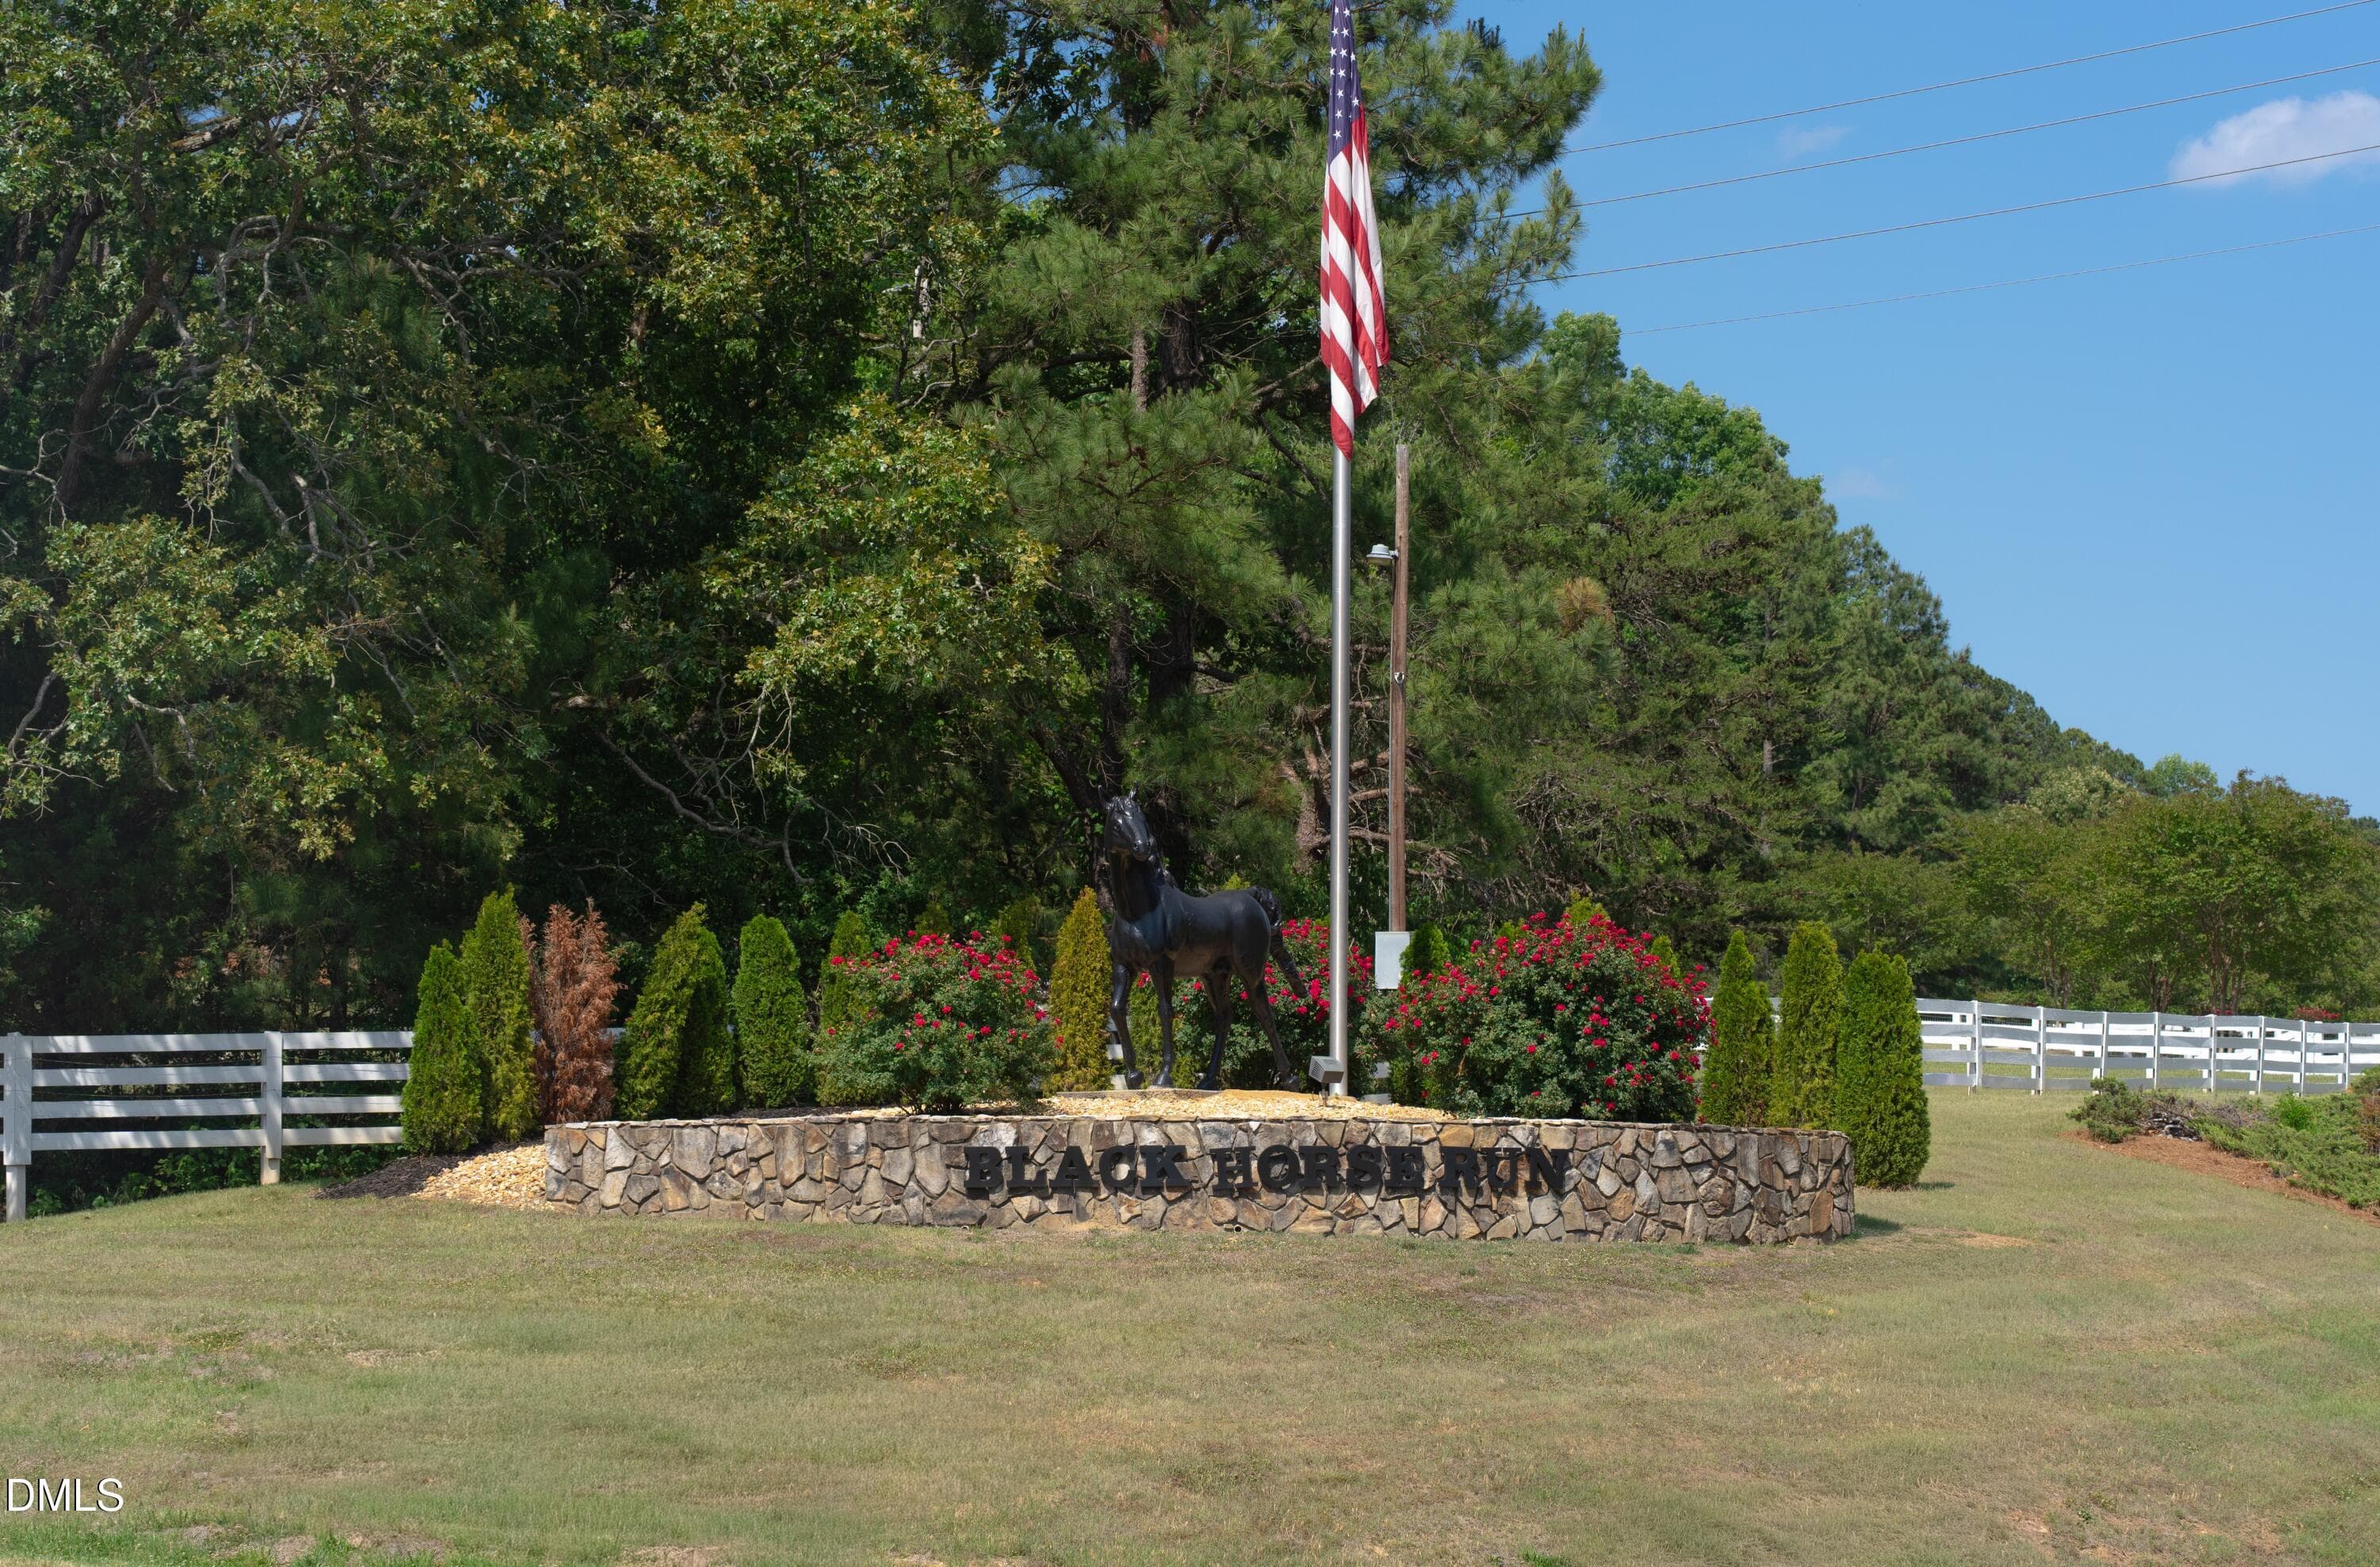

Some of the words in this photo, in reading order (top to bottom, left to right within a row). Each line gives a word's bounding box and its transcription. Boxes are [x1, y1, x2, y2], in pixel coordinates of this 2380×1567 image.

[963, 1145, 1190, 1189] BLACK
[1210, 1145, 1423, 1190] HORSE
[1440, 1146, 1573, 1190] RUN
